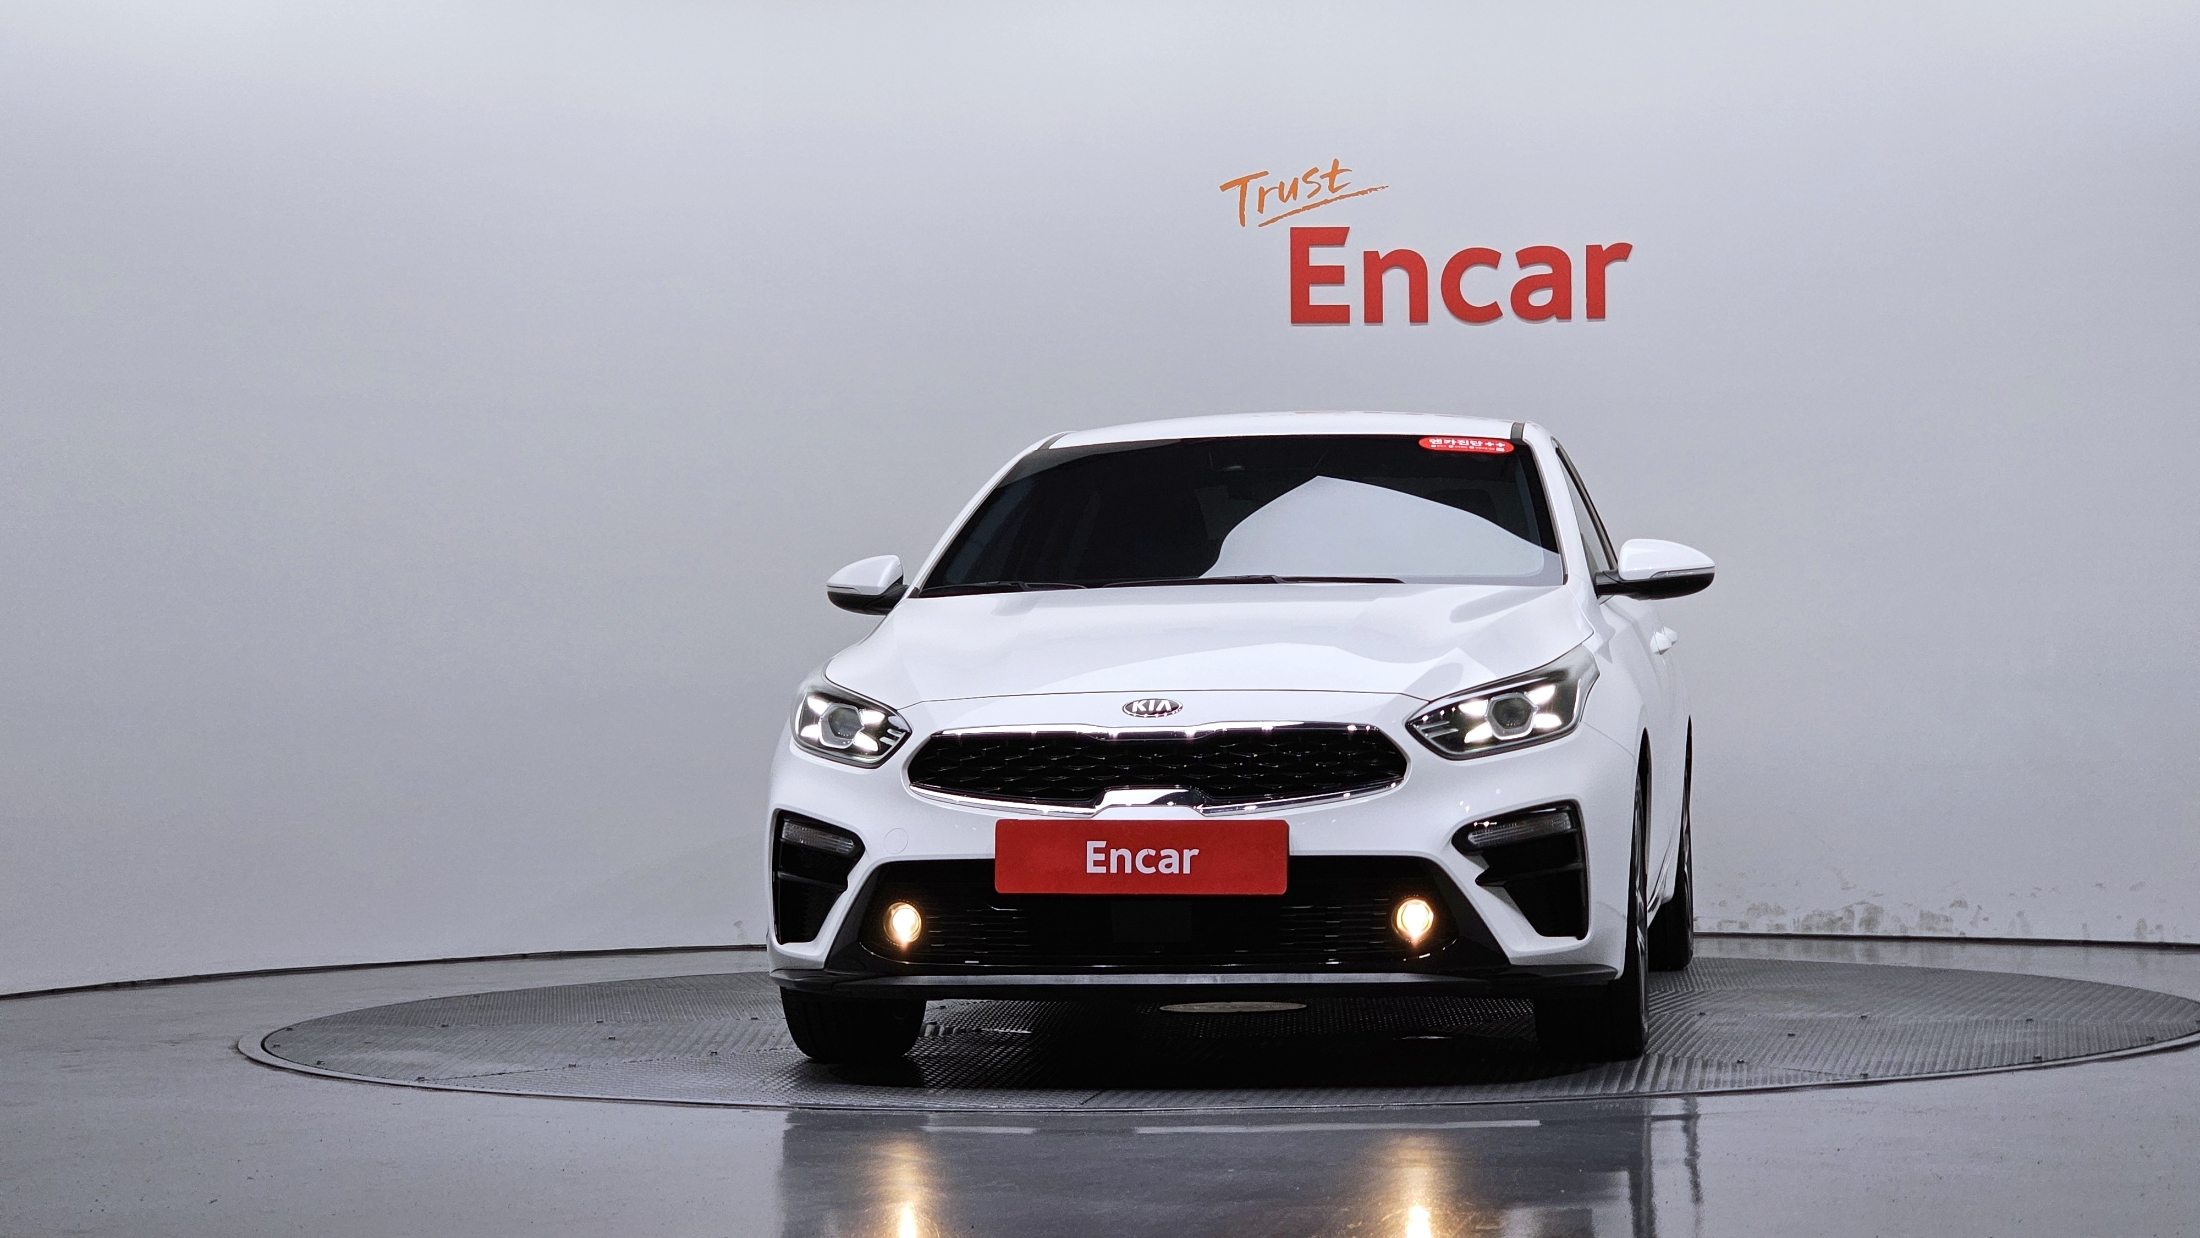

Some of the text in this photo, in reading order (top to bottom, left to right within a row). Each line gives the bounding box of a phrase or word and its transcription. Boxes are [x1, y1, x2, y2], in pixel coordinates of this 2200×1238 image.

[1219, 158, 1353, 228] Trust
[1289, 226, 1633, 325] Encar
[1132, 699, 1172, 712] KIA
[1086, 840, 1200, 874] Encar
